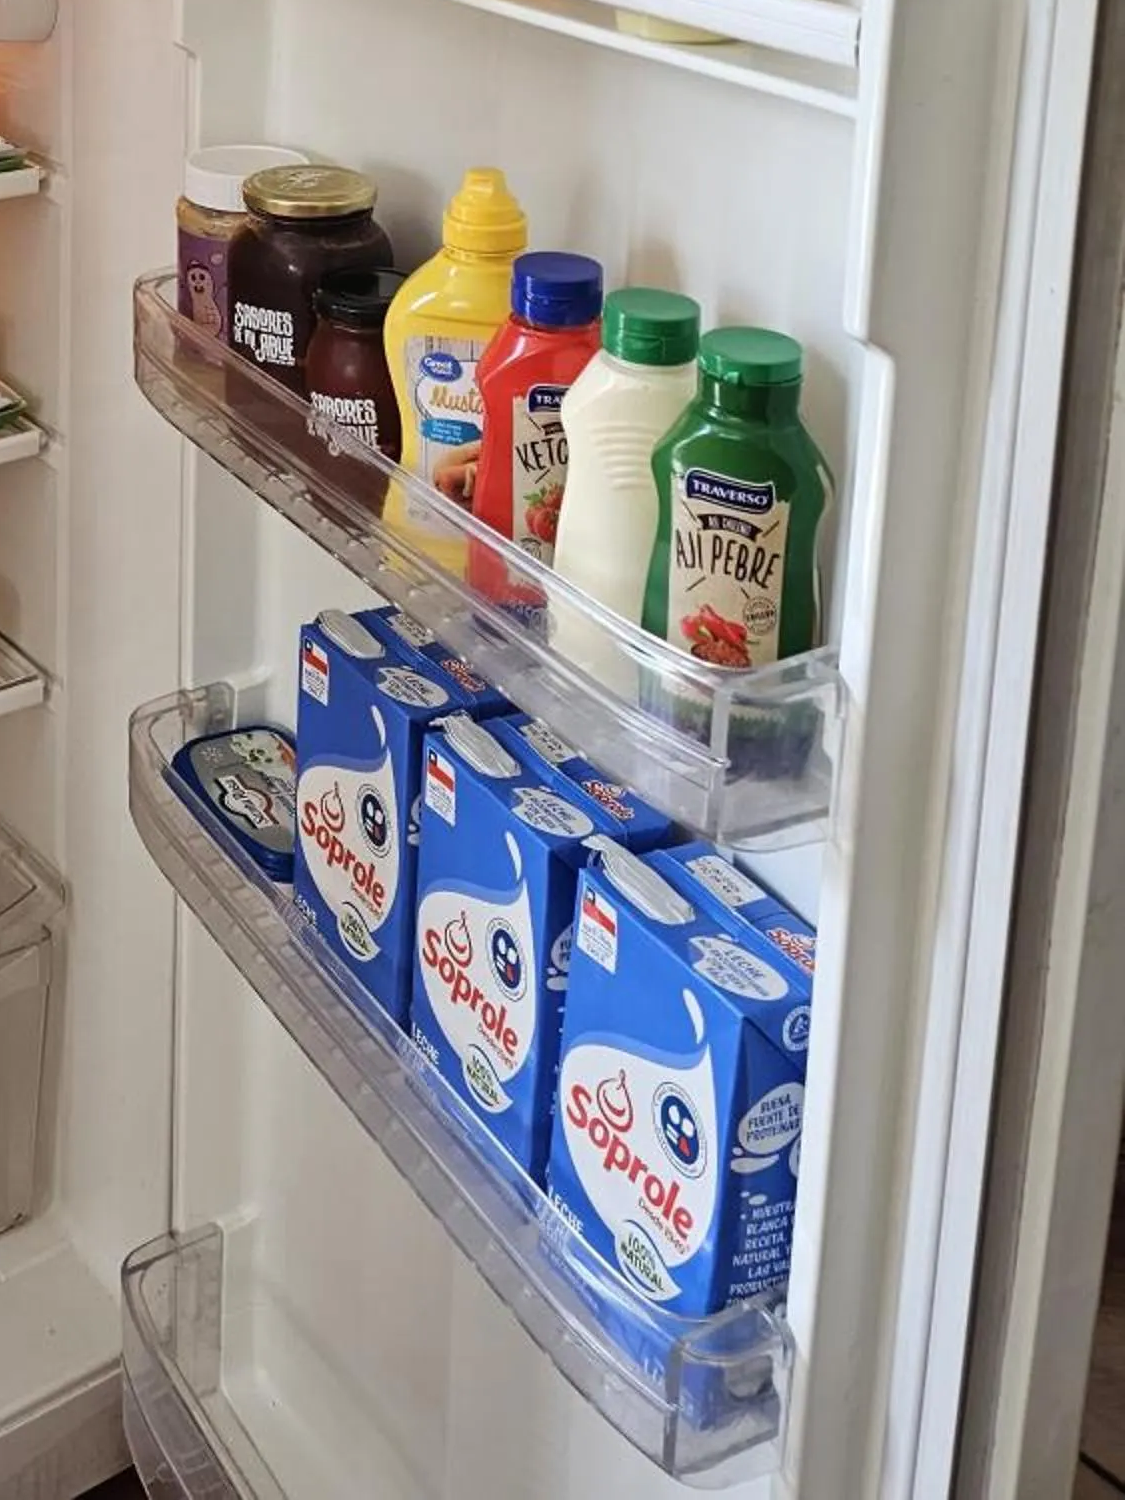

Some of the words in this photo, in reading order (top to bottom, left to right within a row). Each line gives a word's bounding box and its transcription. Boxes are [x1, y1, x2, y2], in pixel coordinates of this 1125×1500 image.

[234, 301, 294, 337] SABORES
[692, 479, 768, 506] TRAVERSO
[711, 534, 779, 588] PEBRE
[301, 801, 385, 908] Soprole
[423, 928, 518, 1057] Soprole
[567, 1083, 693, 1240] Soprole
[620, 1240, 665, 1292] NATURAL
